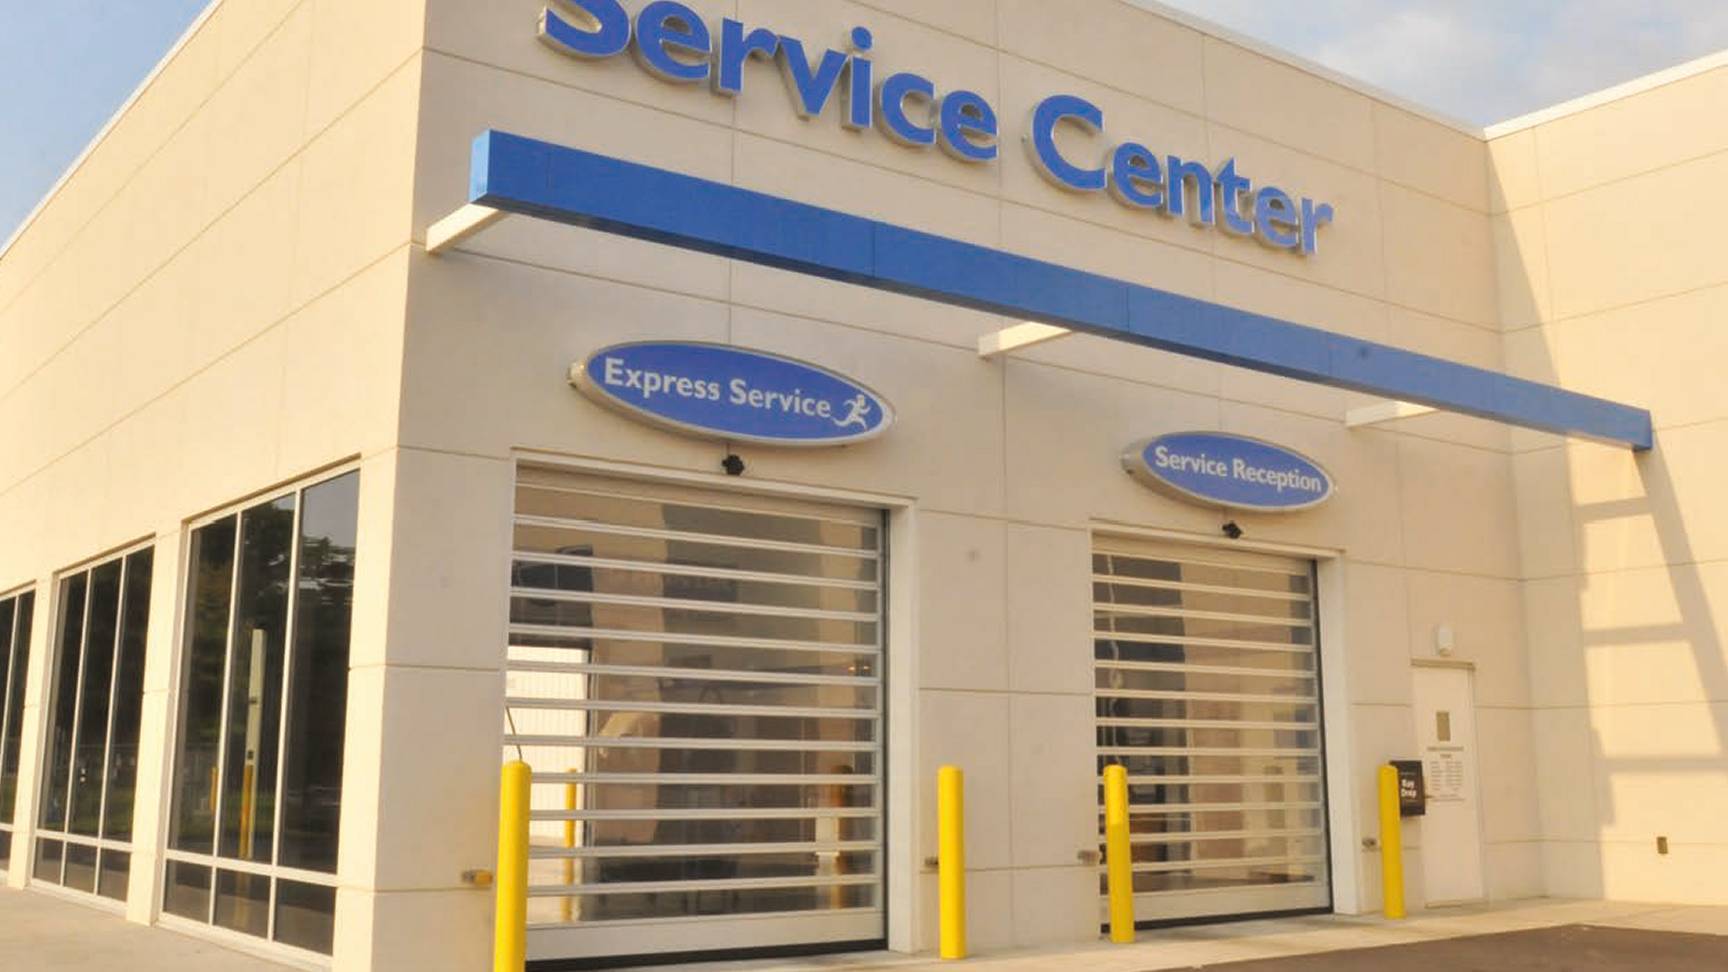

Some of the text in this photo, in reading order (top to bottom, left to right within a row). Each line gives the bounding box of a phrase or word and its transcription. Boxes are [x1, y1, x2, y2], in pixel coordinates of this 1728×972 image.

[1031, 94, 1335, 254] Center
[605, 357, 831, 418] Express Service
[1155, 445, 1322, 492] Service Reception
